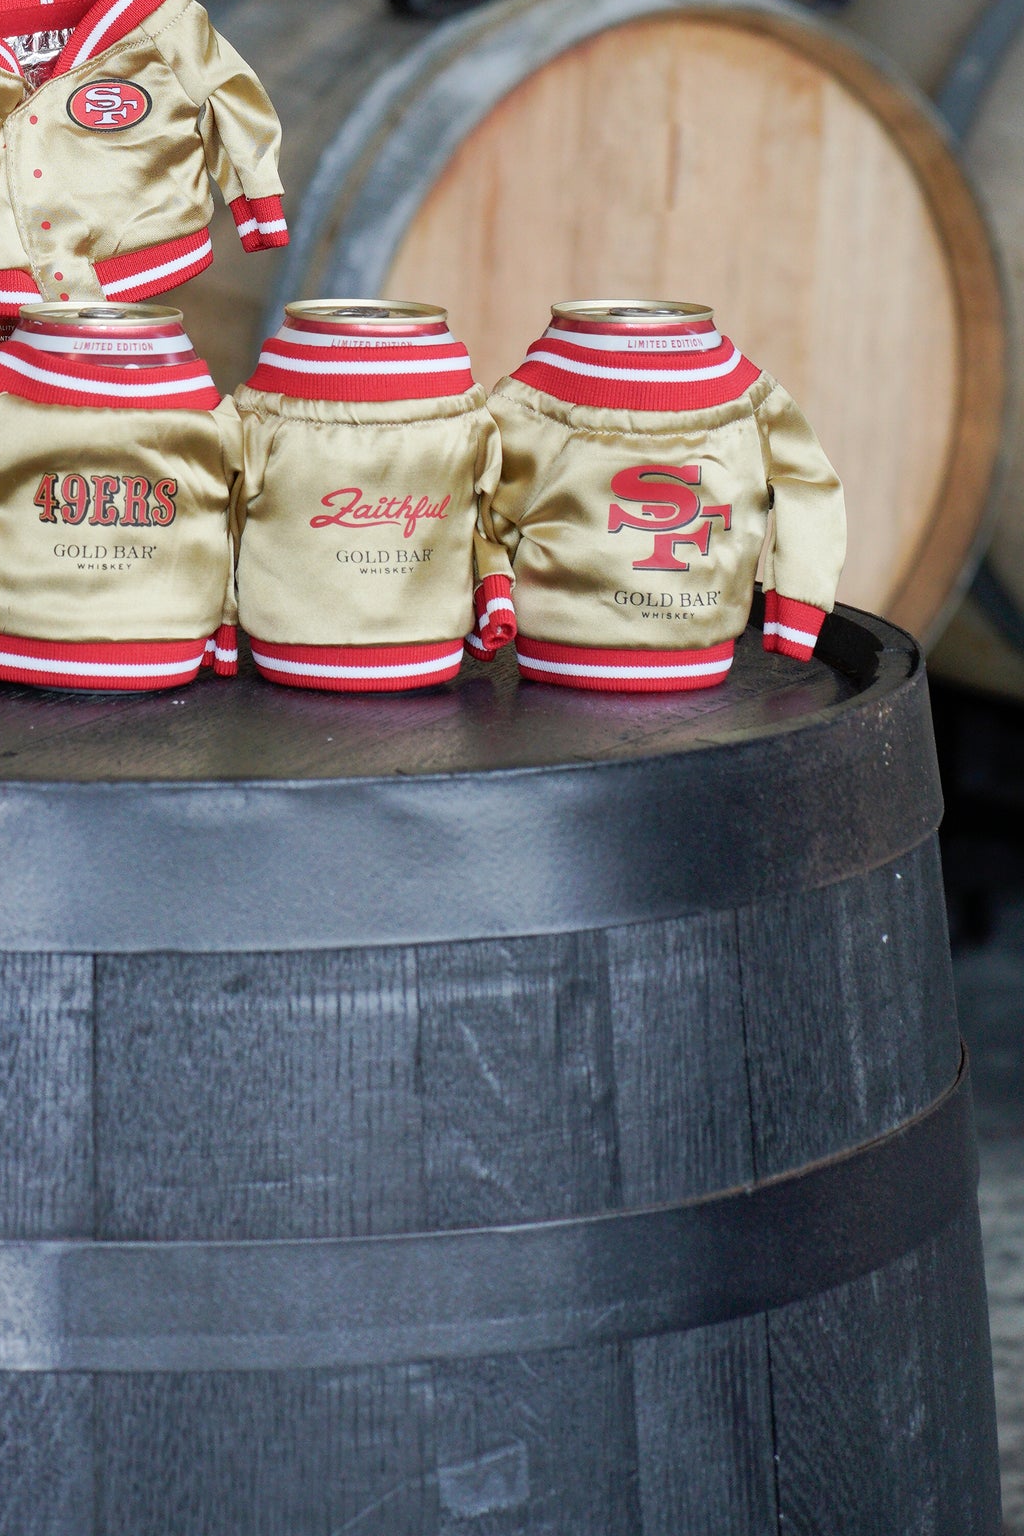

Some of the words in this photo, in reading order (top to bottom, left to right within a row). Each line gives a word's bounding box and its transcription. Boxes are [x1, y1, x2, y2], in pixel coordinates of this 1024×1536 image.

[85, 87, 138, 125] SF
[73, 341, 113, 351] LIMITED
[117, 342, 154, 351] EDITION
[627, 339, 667, 349] LIMITED
[671, 338, 704, 348] EDITION
[33, 472, 179, 527] 49ERS
[309, 487, 452, 539] Faithful
[607, 464, 733, 572] SF
[53, 543, 108, 559] GOLD
[336, 549, 391, 564] GOLD
[77, 563, 133, 571] WHISKEY
[359, 567, 415, 575] WHISKEY
[614, 590, 674, 608] GOLD
[641, 611, 696, 620] WHISKEY
